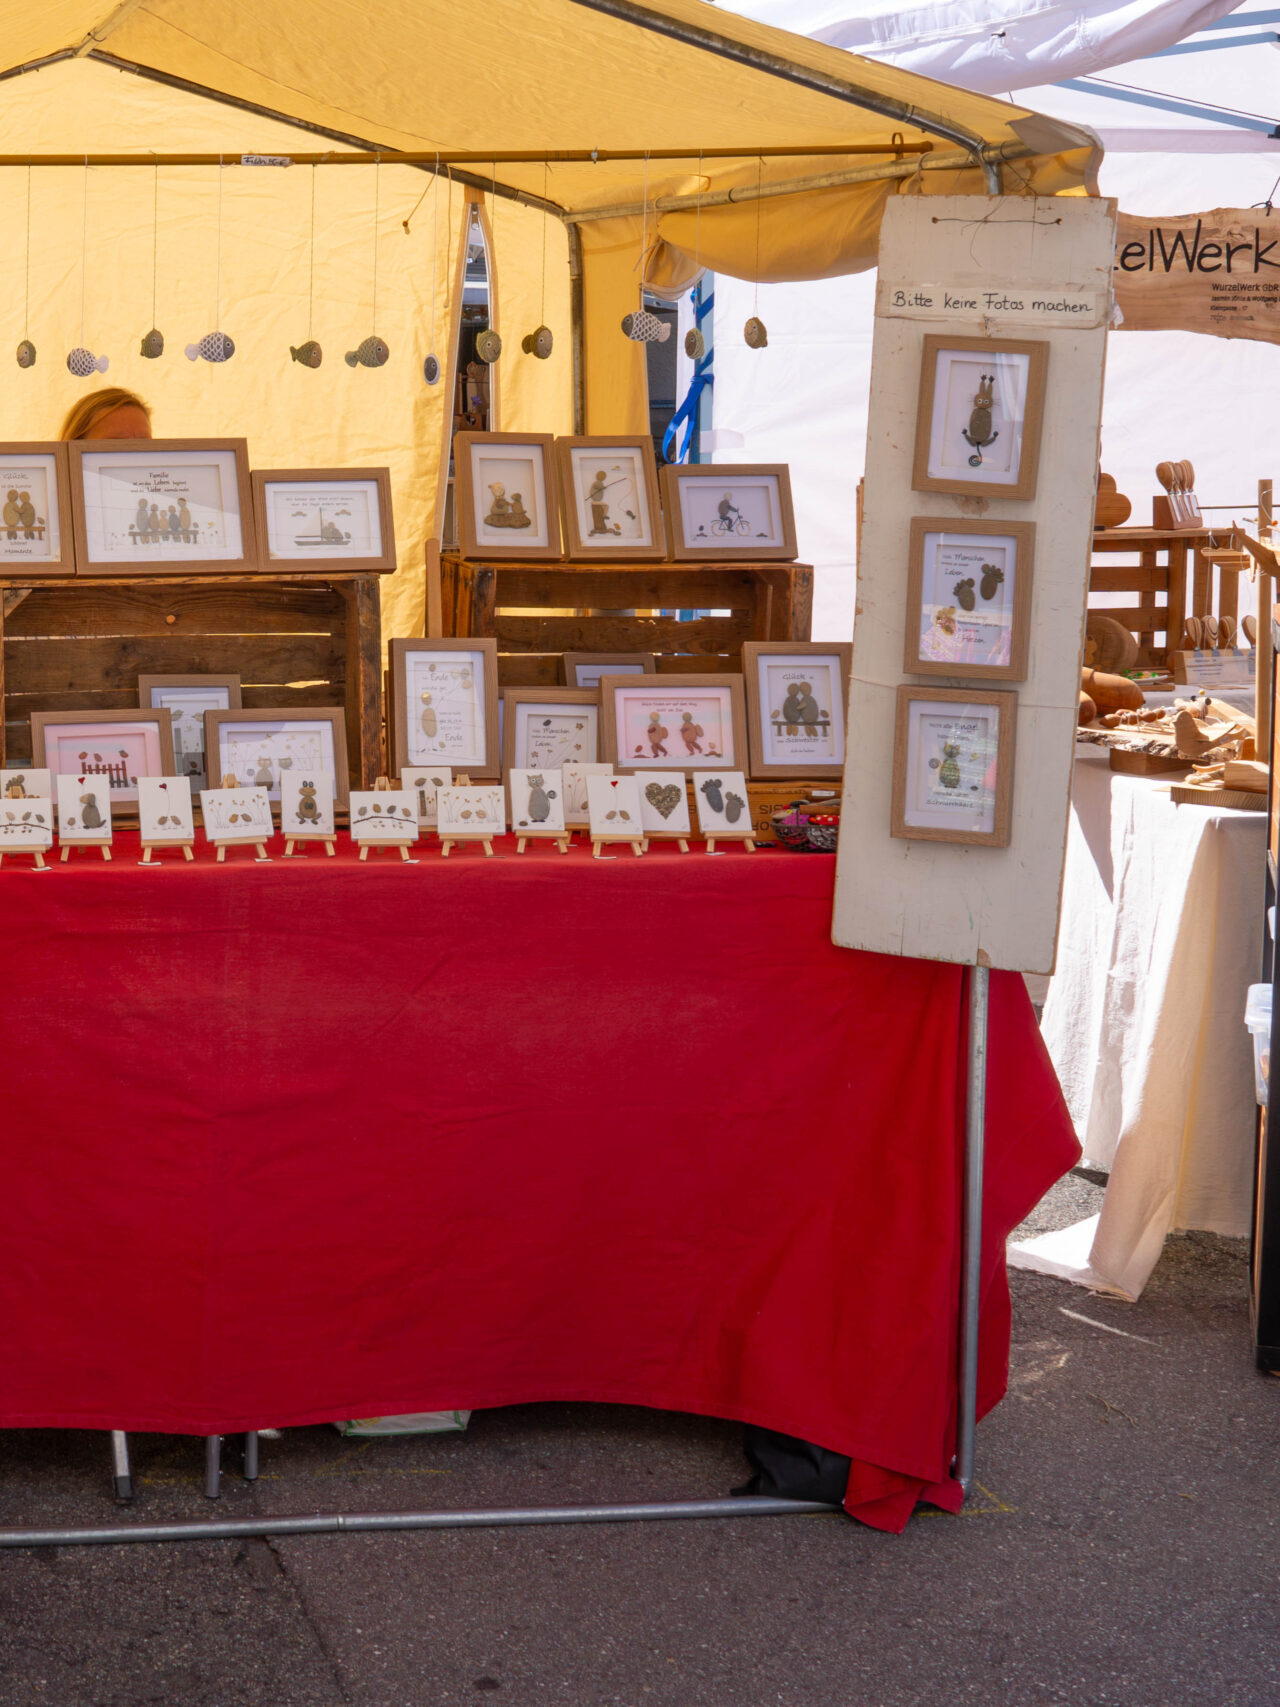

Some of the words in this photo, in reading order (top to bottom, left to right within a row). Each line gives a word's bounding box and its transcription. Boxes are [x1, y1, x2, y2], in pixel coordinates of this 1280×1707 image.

[1114, 218, 1280, 273] elWerk
[1211, 282, 1260, 292] WurzelWerk
[892, 290, 933, 307] Bitte
[982, 293, 1024, 310] Fotos
[1032, 298, 1094, 313] machen
